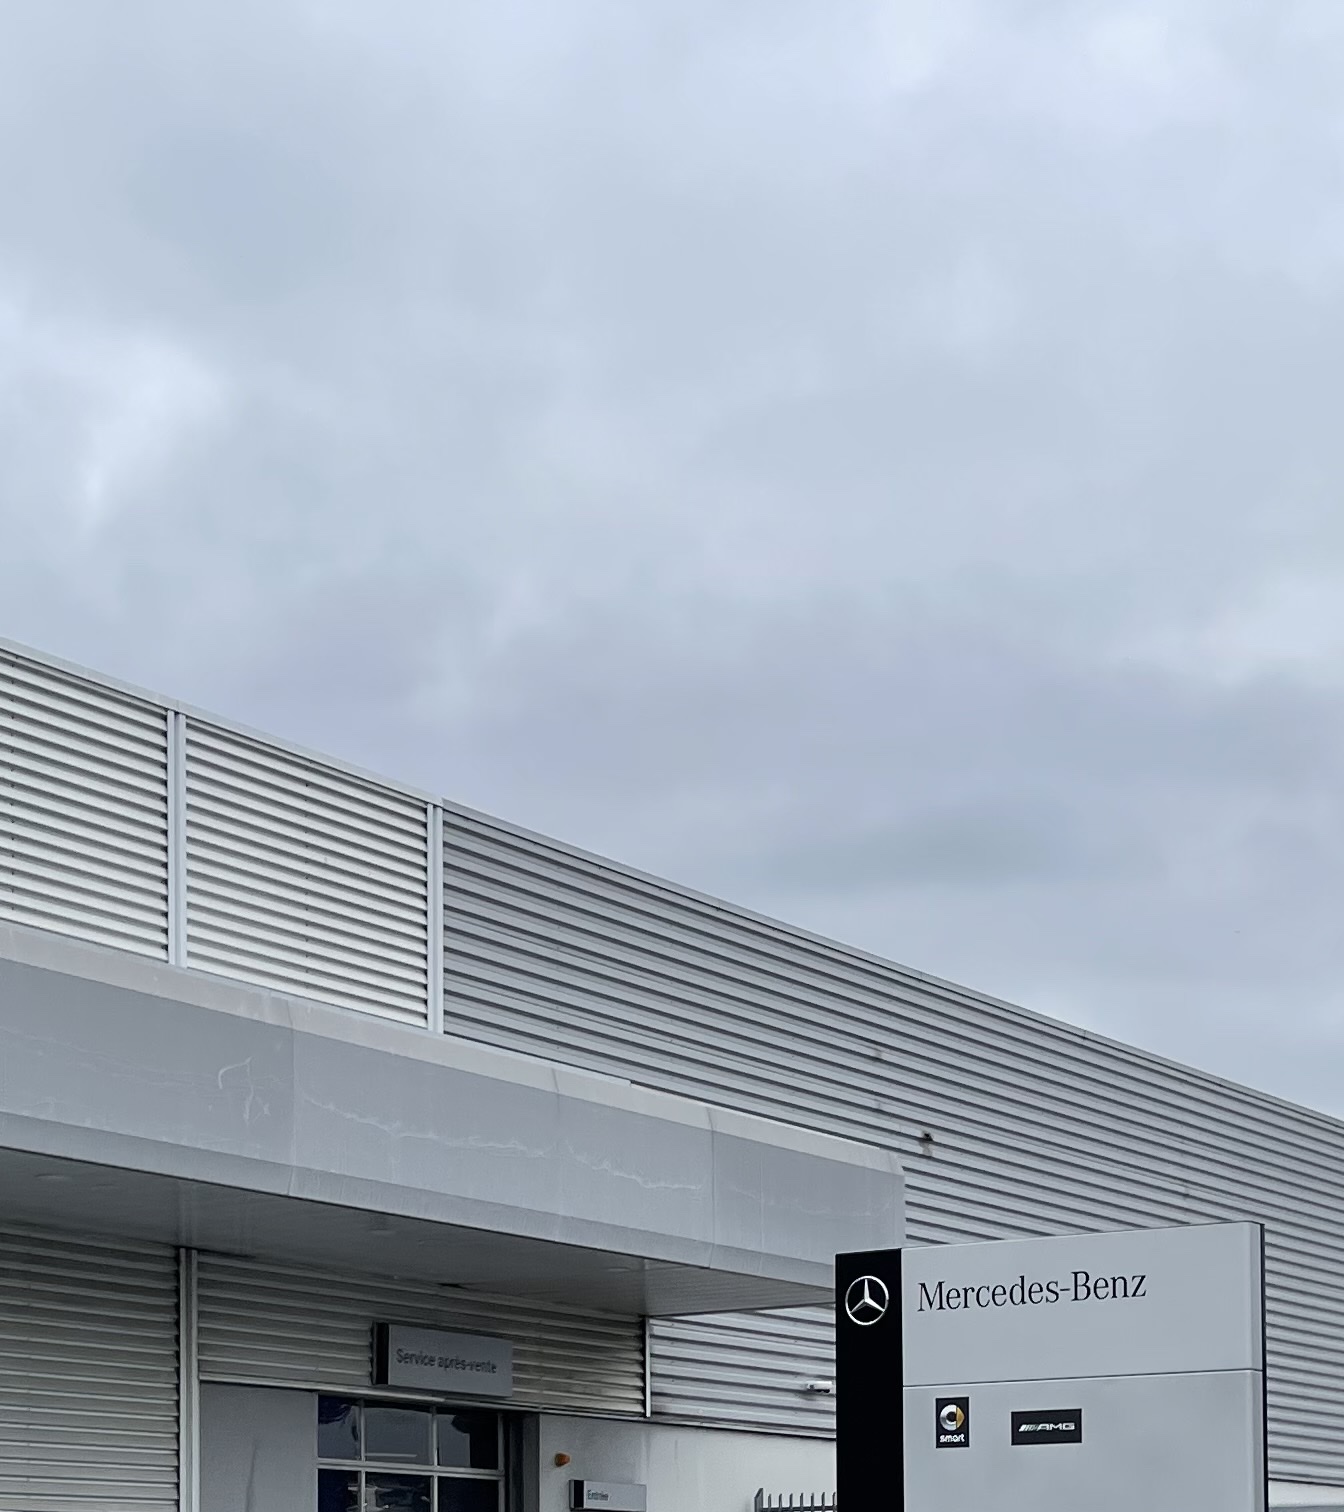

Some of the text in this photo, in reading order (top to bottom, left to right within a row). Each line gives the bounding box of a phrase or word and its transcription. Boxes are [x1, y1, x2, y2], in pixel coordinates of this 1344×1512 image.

[917, 1270, 1147, 1312] Mercedes-Benz
[396, 1348, 435, 1367] Service
[939, 1433, 966, 1443] smart
